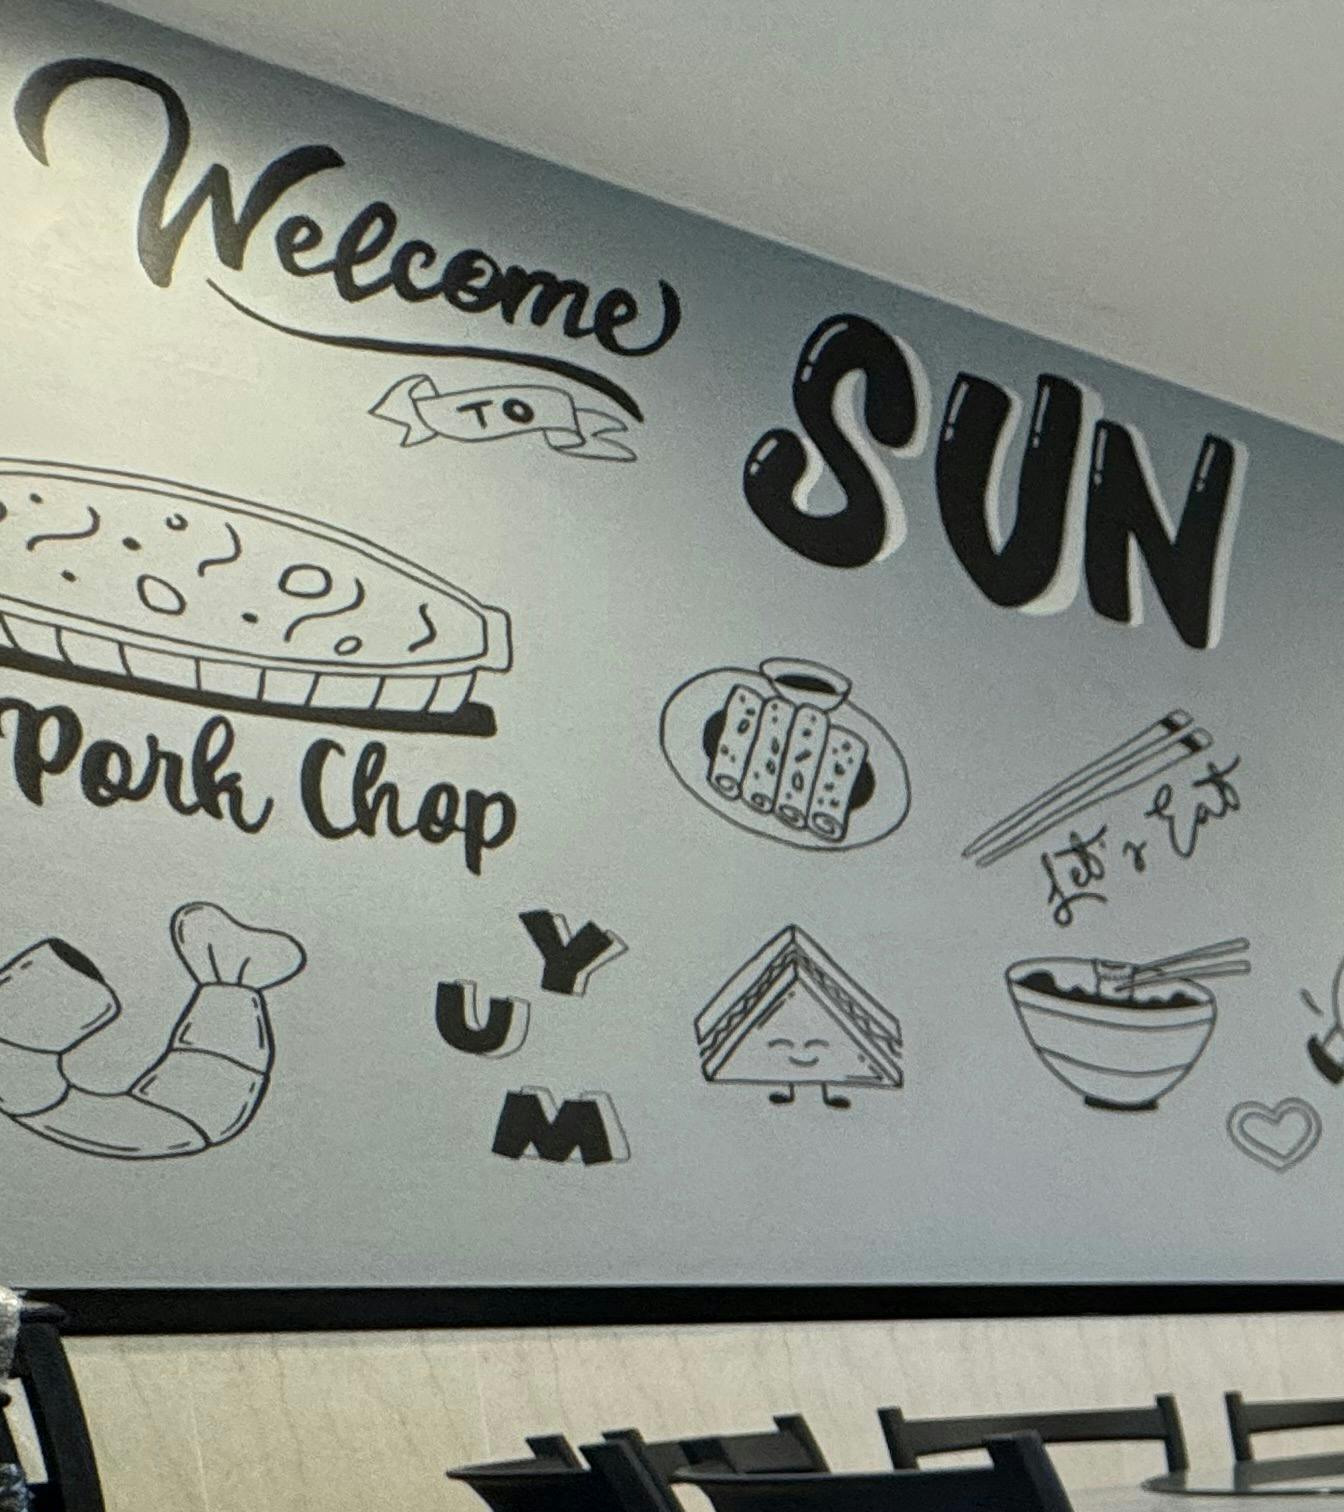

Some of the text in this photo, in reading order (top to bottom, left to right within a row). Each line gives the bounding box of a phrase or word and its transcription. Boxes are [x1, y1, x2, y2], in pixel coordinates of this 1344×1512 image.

[14, 58, 681, 357] Welcome
[457, 397, 535, 430] TO
[743, 313, 1250, 650] SUN
[0, 697, 517, 876] Pork Chop
